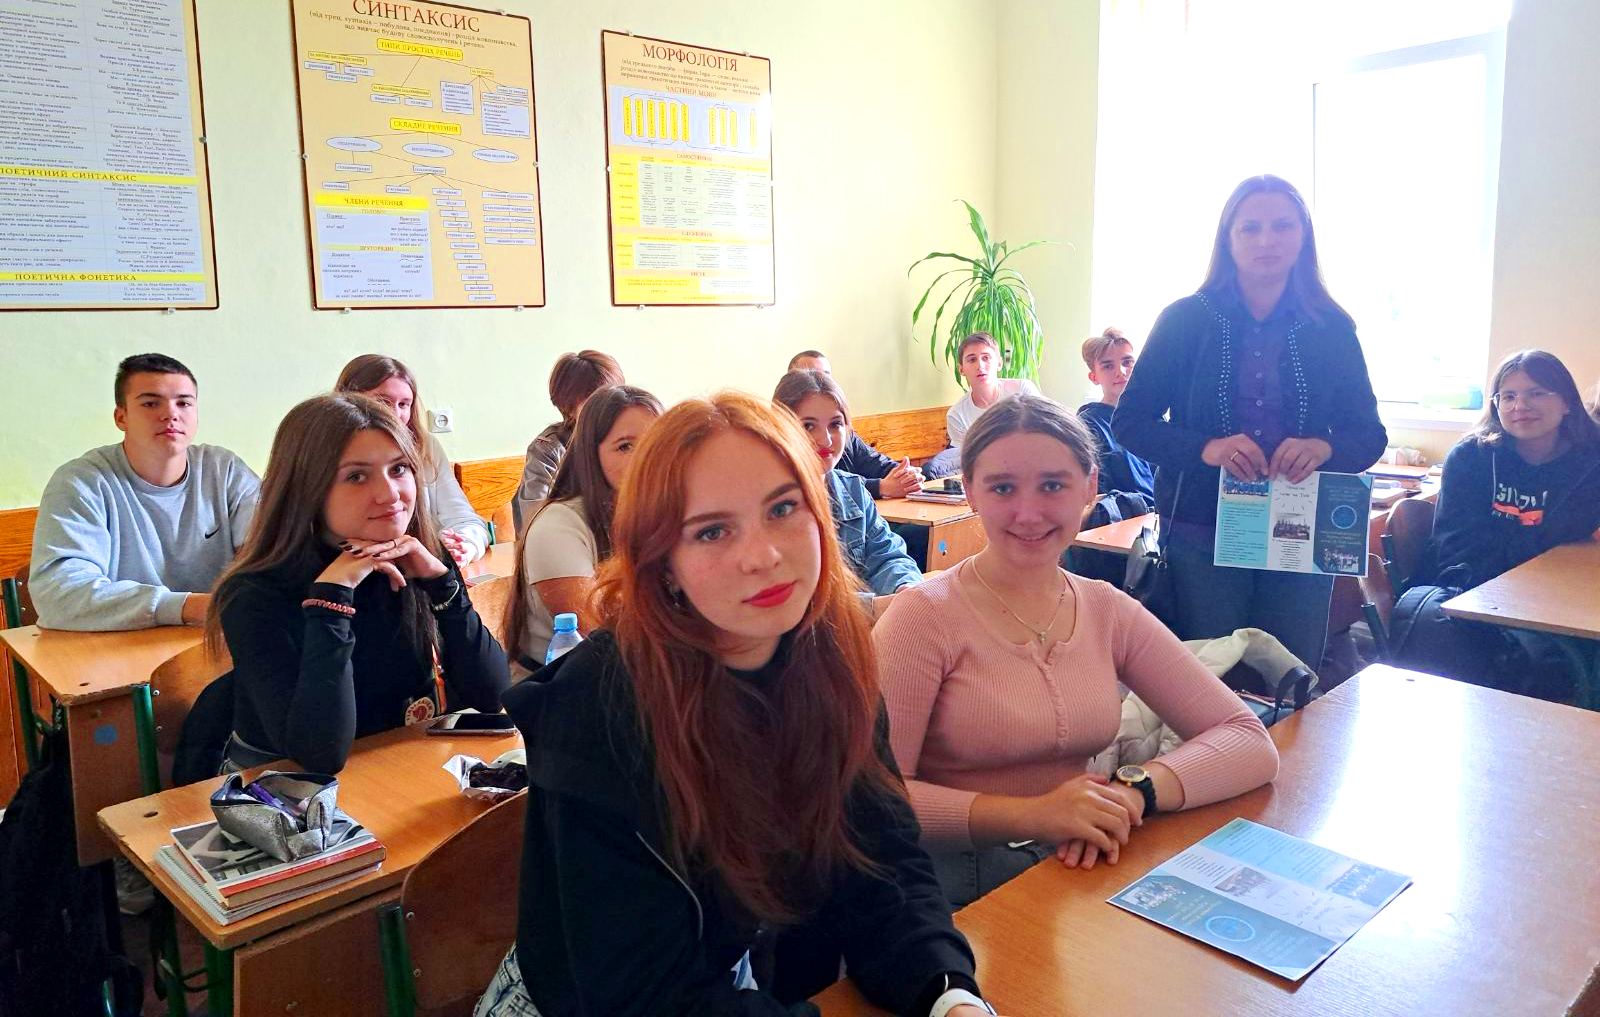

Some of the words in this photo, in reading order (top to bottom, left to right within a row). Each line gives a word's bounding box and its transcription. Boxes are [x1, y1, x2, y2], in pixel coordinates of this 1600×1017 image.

[352, 0, 480, 32] СИНТАКСИС
[642, 43, 738, 72] МОРФОЛОГІЯ
[72, 172, 137, 182] СИНТАКСИС
[15, 273, 76, 281] ПОЕТИЧНА
[80, 273, 137, 281] ФОНЕТИКА
